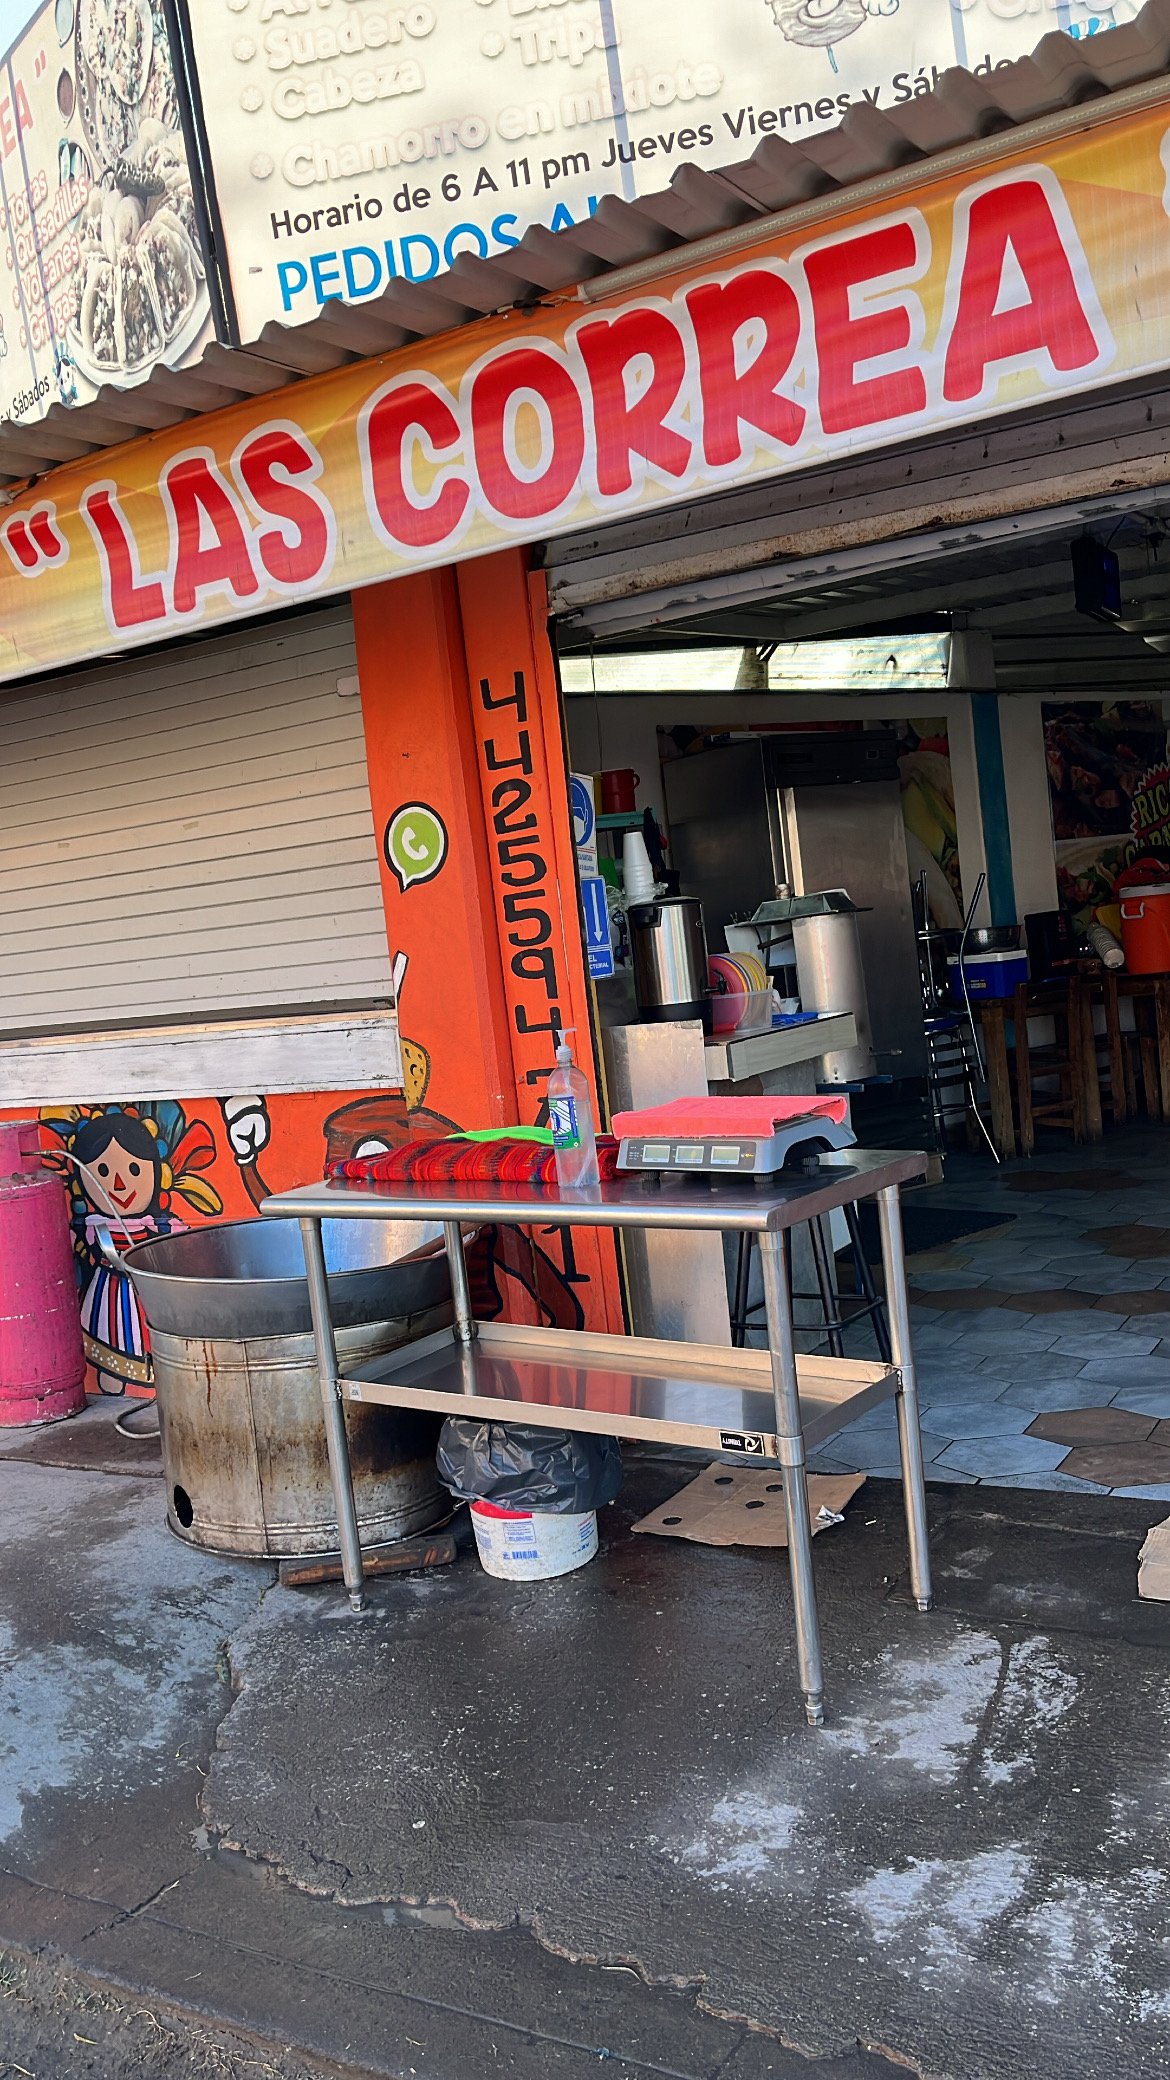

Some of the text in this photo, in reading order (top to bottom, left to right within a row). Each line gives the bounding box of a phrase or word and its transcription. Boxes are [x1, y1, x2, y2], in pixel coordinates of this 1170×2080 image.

[264, 3, 437, 70] Suadero
[511, 12, 622, 66] Tripa
[272, 58, 425, 120] Cabeza
[271, 194, 383, 239] Horario
[393, 183, 431, 212] de
[441, 174, 462, 202] 6
[473, 166, 499, 197] A
[507, 157, 531, 187] 11
[542, 151, 590, 189] pm
[601, 124, 714, 168] Jueves
[723, 93, 851, 139] Viernes
[281, 114, 490, 187] Chamorro
[496, 98, 555, 140] en
[277, 213, 520, 311] PEDIDOS
[13, 376, 50, 419] Sábados
[368, 180, 1100, 548] CORREA
